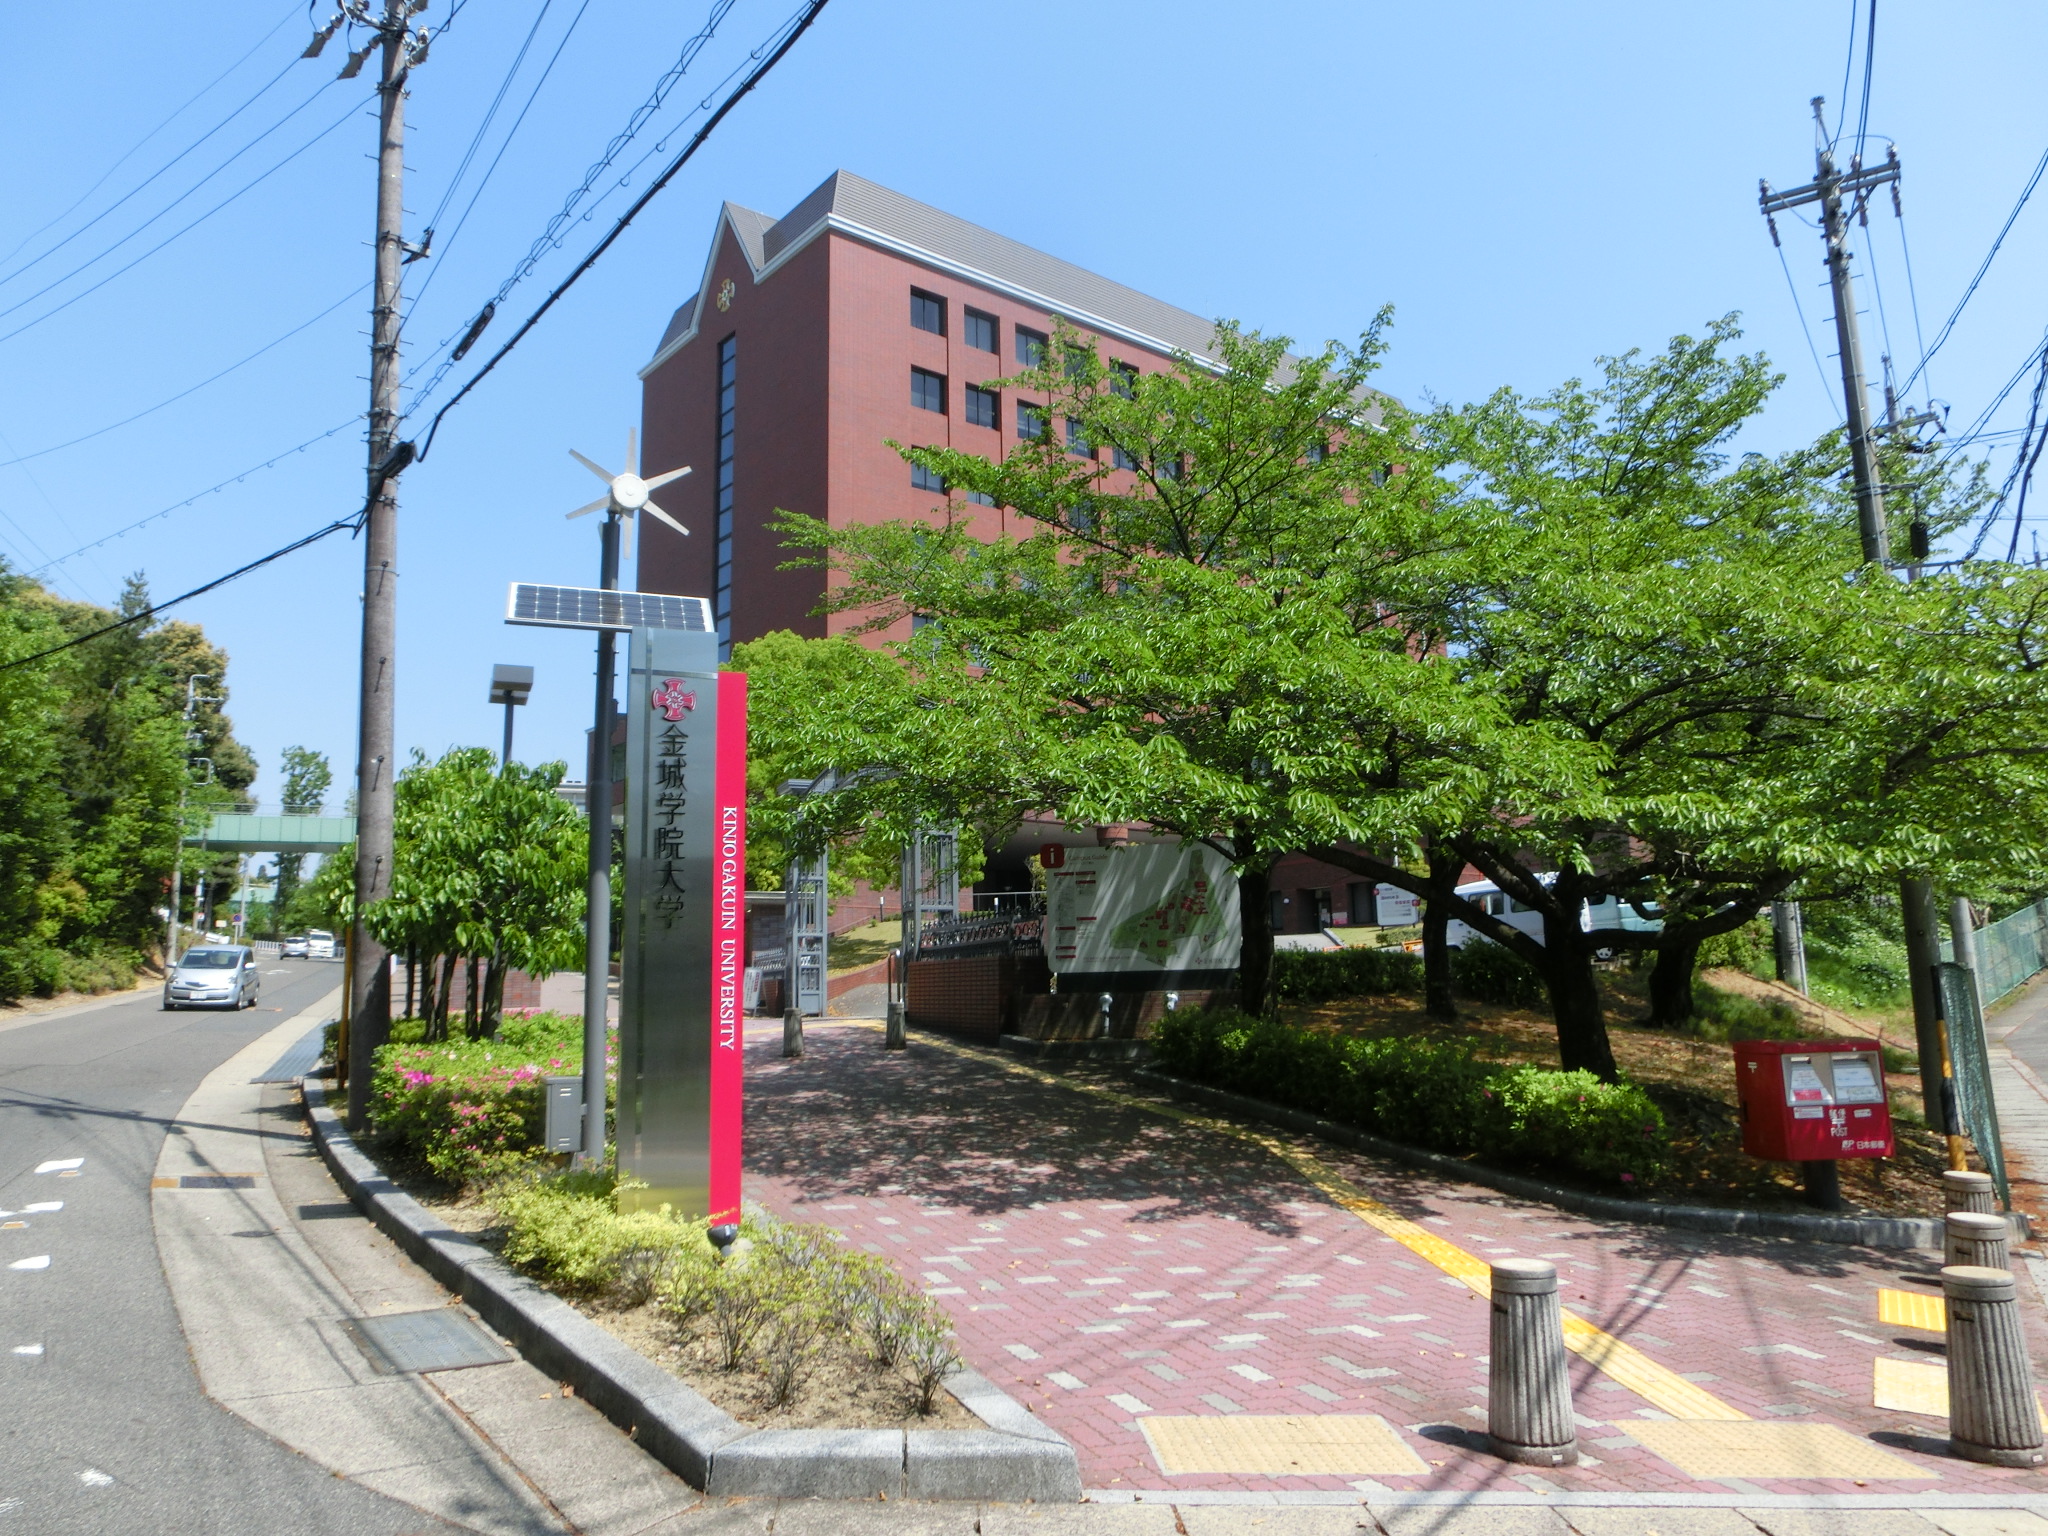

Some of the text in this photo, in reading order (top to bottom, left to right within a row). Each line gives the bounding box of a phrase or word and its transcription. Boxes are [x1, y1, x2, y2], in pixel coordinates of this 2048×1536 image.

[656, 724, 688, 929] 金城学院大学
[719, 806, 737, 1051] KINJO GAKUIN UNIVERSITY
[1831, 1127, 1847, 1136] POST
